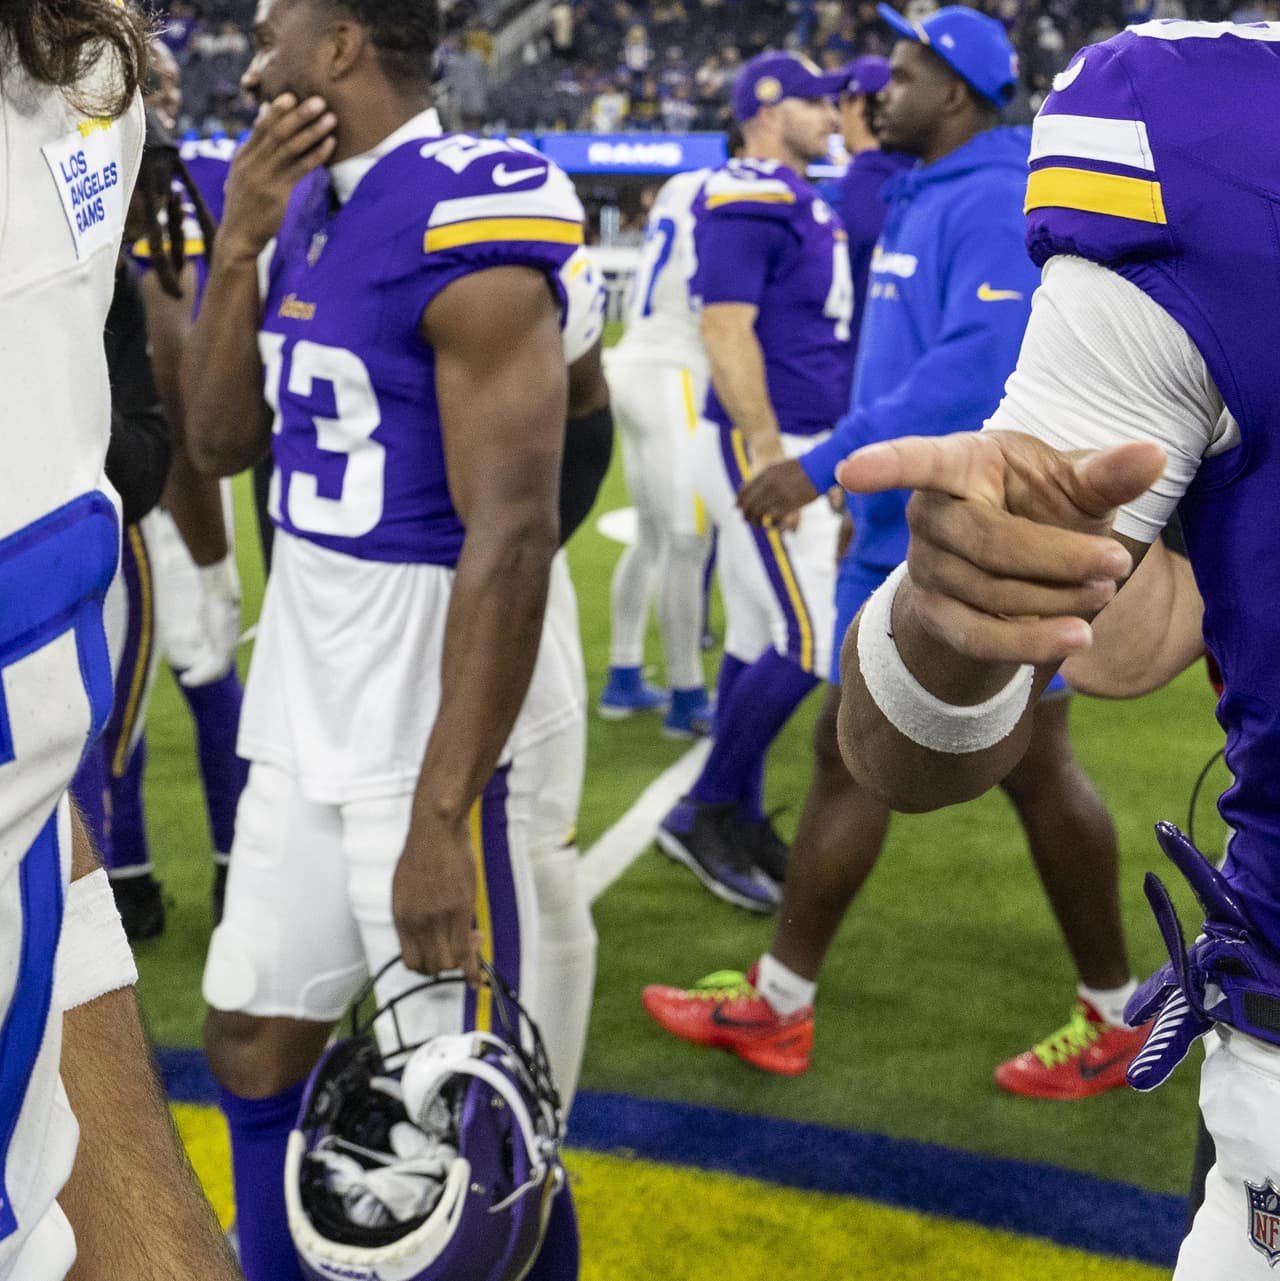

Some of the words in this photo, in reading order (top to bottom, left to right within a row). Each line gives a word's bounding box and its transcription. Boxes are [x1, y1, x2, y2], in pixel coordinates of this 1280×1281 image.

[60, 150, 87, 183] LOS
[70, 162, 117, 209] ANGELES
[75, 197, 105, 234] RAMS
